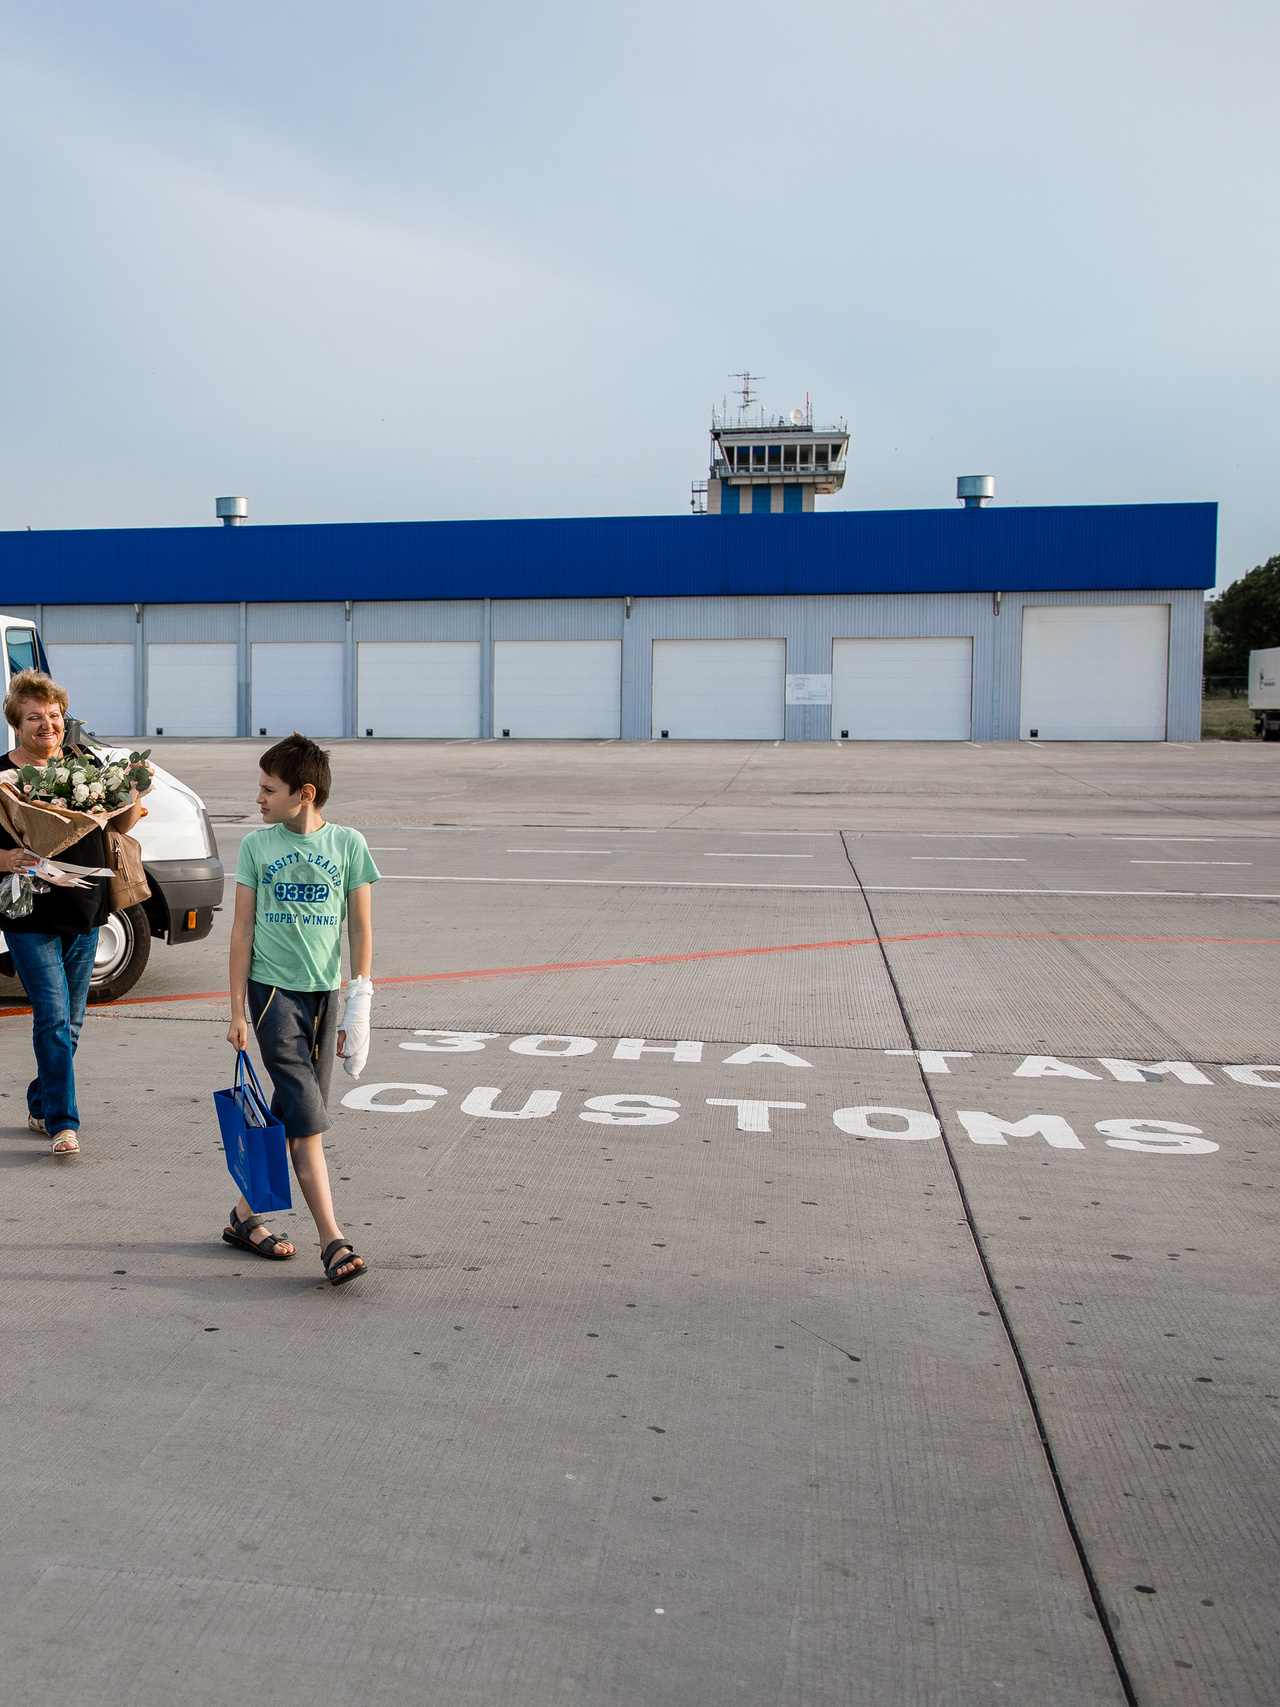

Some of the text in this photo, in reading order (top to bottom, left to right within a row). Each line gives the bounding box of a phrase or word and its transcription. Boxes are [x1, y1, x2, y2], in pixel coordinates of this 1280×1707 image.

[261, 852, 342, 888] VARSITY LEADER
[275, 883, 328, 902] 93-82
[265, 912, 338, 926] TROPHY WINNER
[398, 1030, 815, 1067] ЗОНА
[340, 1082, 1220, 1154] CUSTOMS
